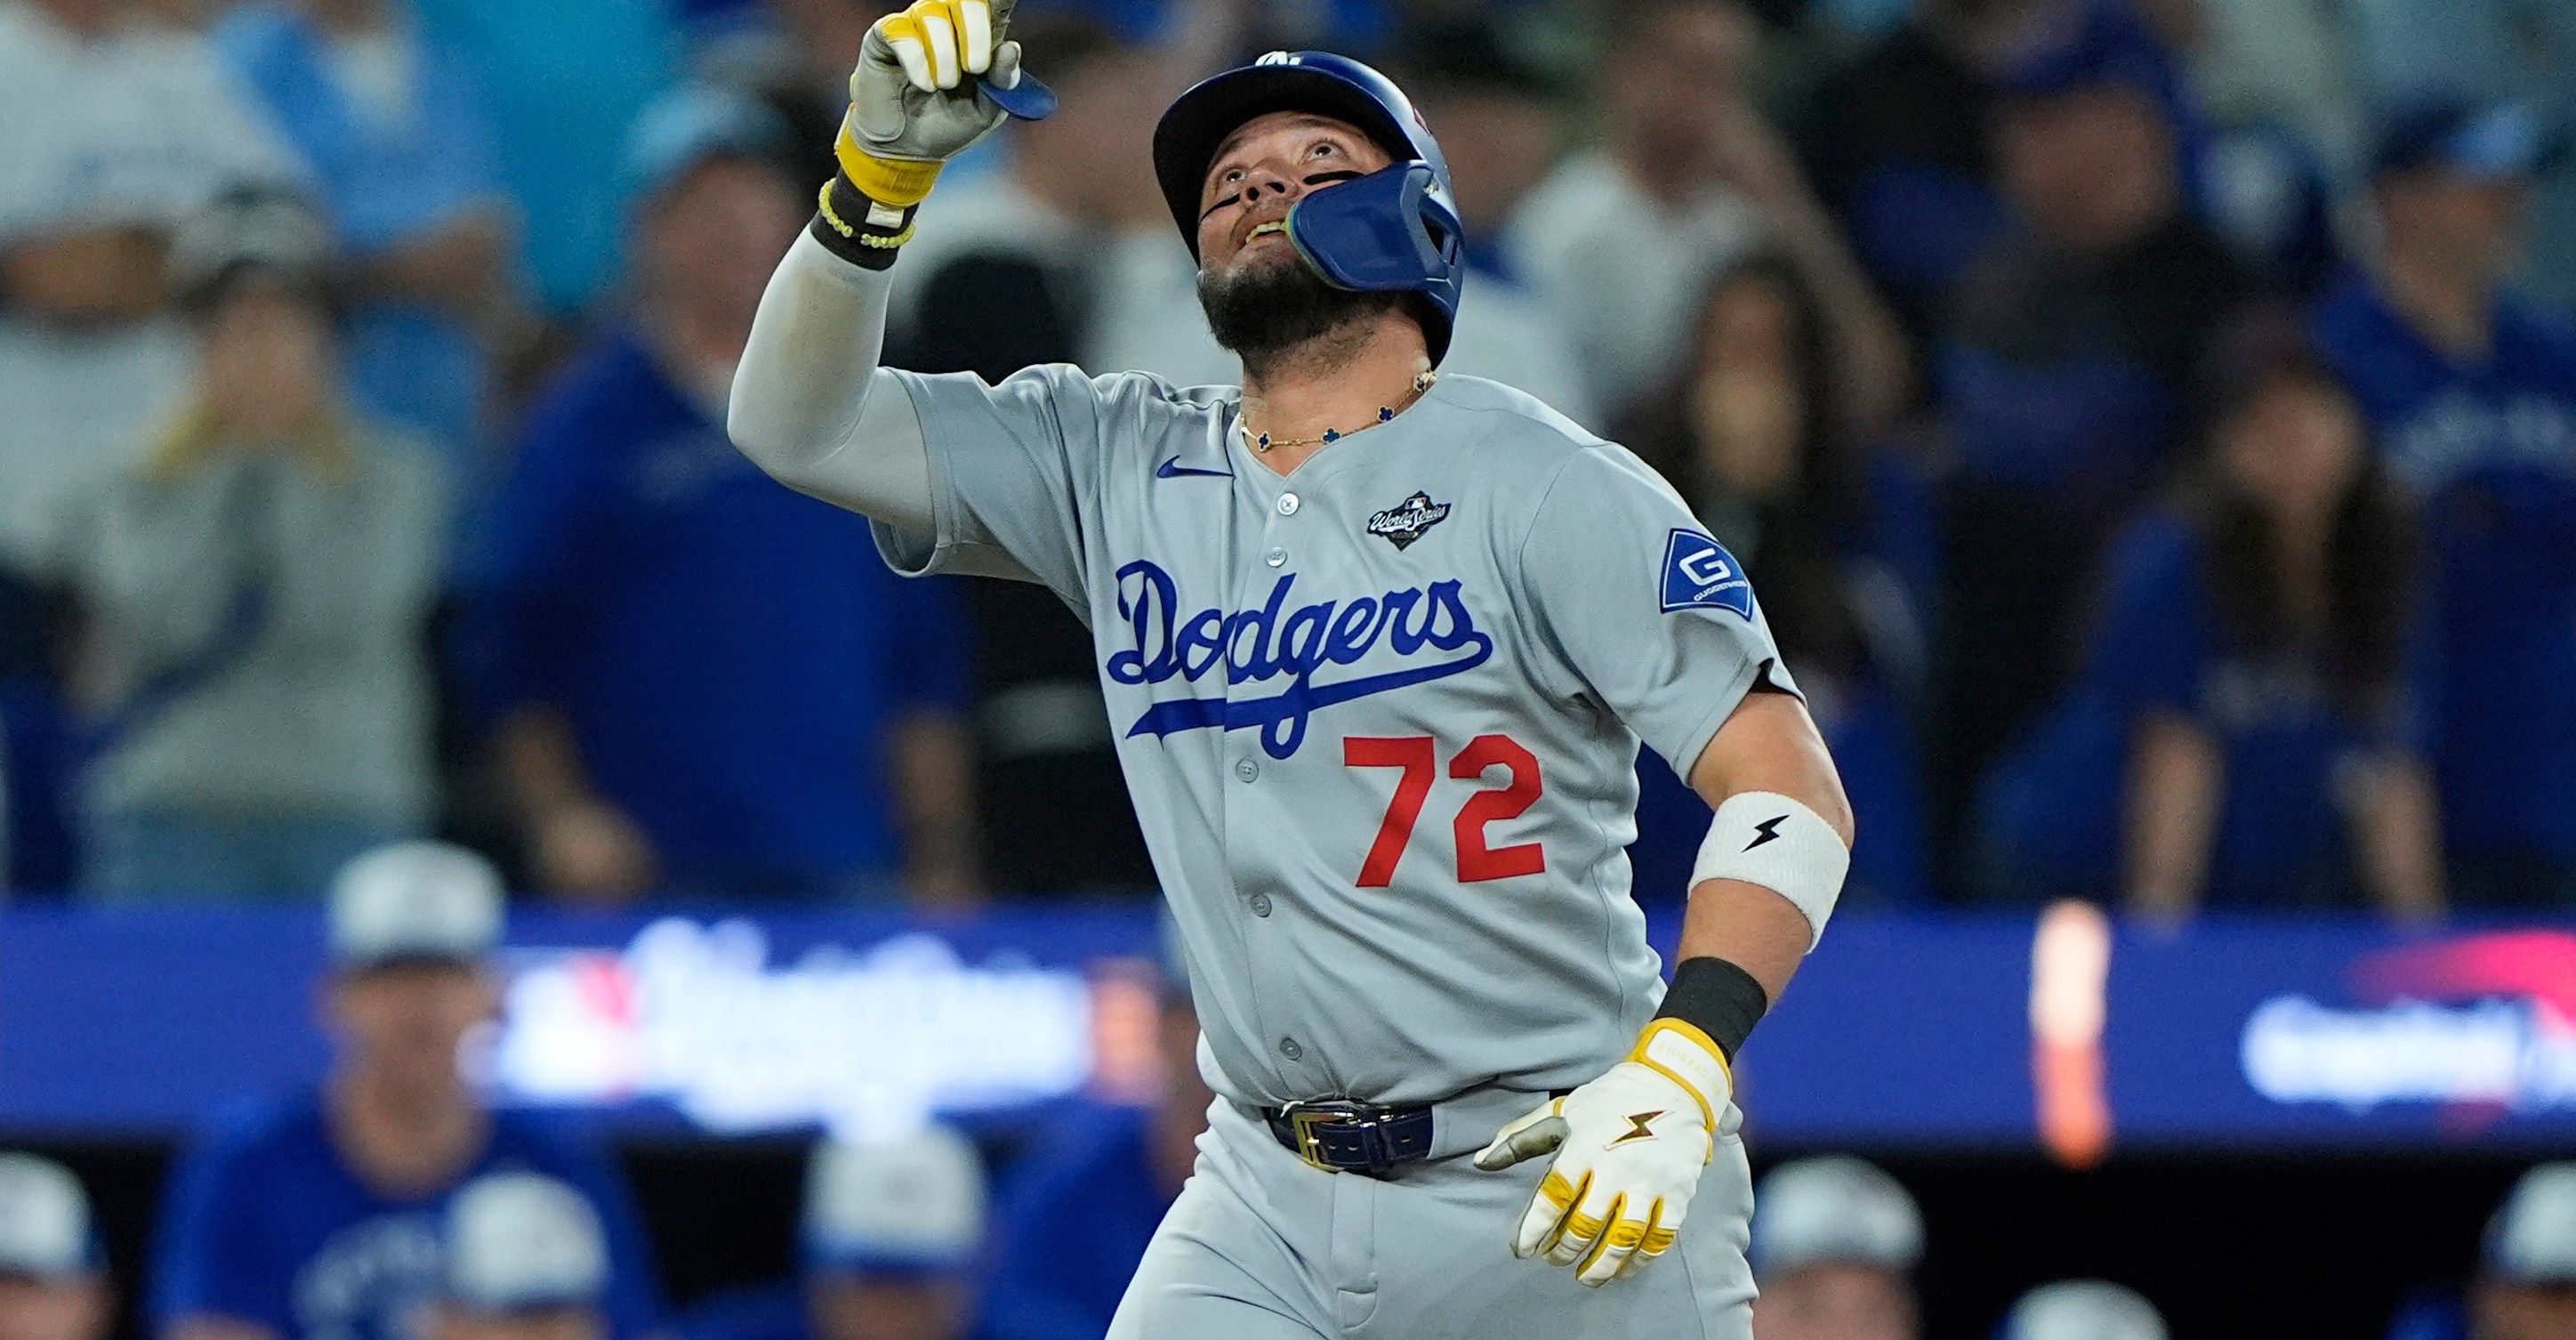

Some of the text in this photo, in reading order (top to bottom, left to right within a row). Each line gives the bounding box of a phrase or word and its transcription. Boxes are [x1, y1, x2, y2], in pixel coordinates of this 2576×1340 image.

[1370, 509, 1413, 532] World
[1678, 547, 1732, 586] G
[1107, 559, 1493, 761] Dodgers
[1343, 734, 1545, 888] 72
